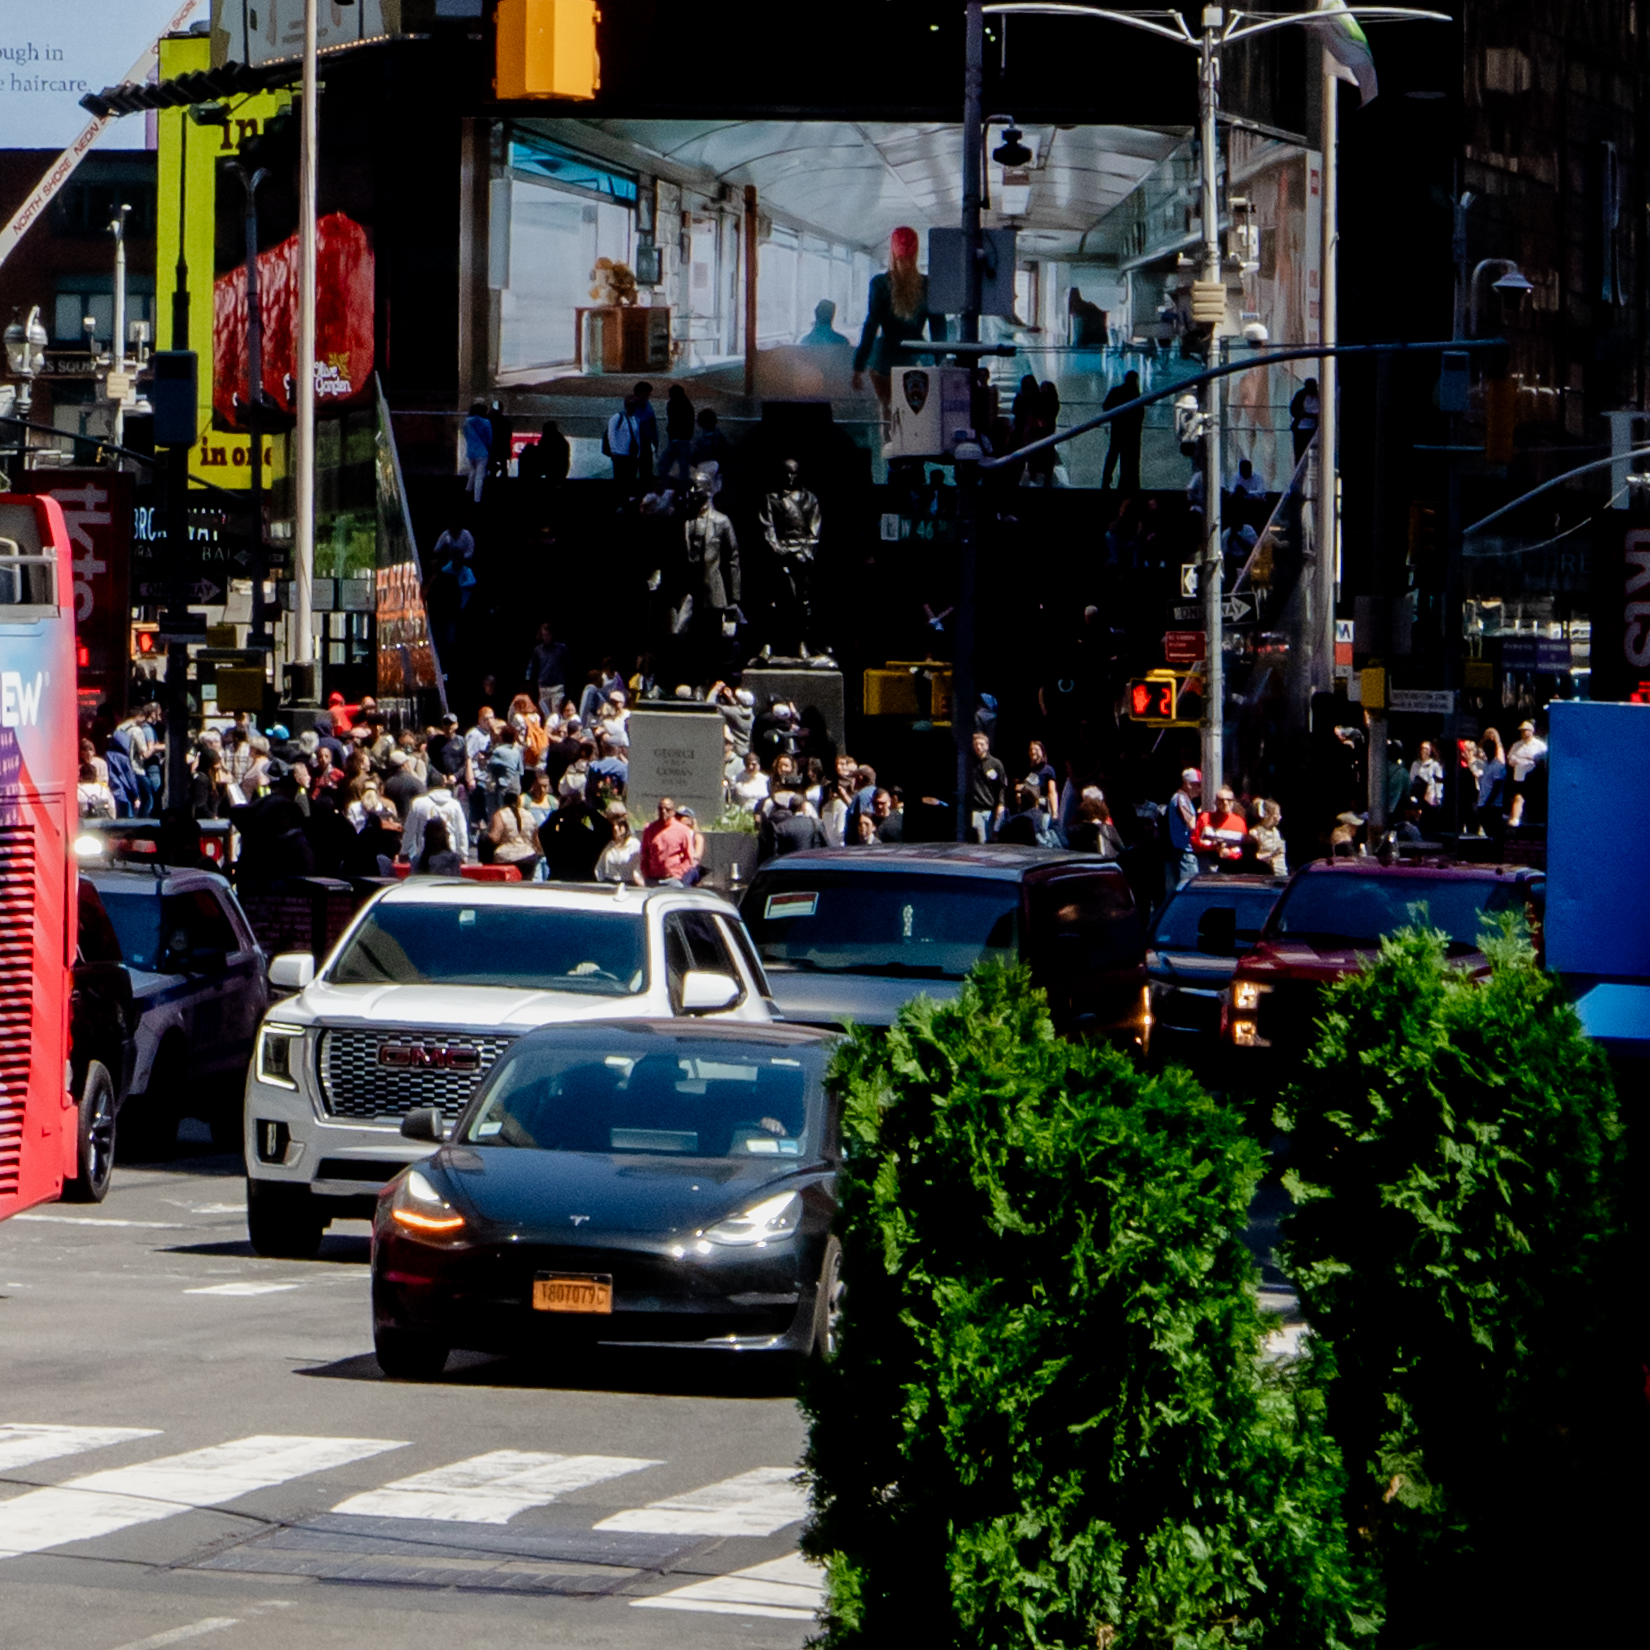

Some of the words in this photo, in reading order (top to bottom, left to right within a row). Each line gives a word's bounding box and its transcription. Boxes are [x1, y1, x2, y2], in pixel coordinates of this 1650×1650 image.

[46, 45, 65, 61] in
[315, 379, 352, 398] Garden
[380, 1046, 479, 1070] GMC
